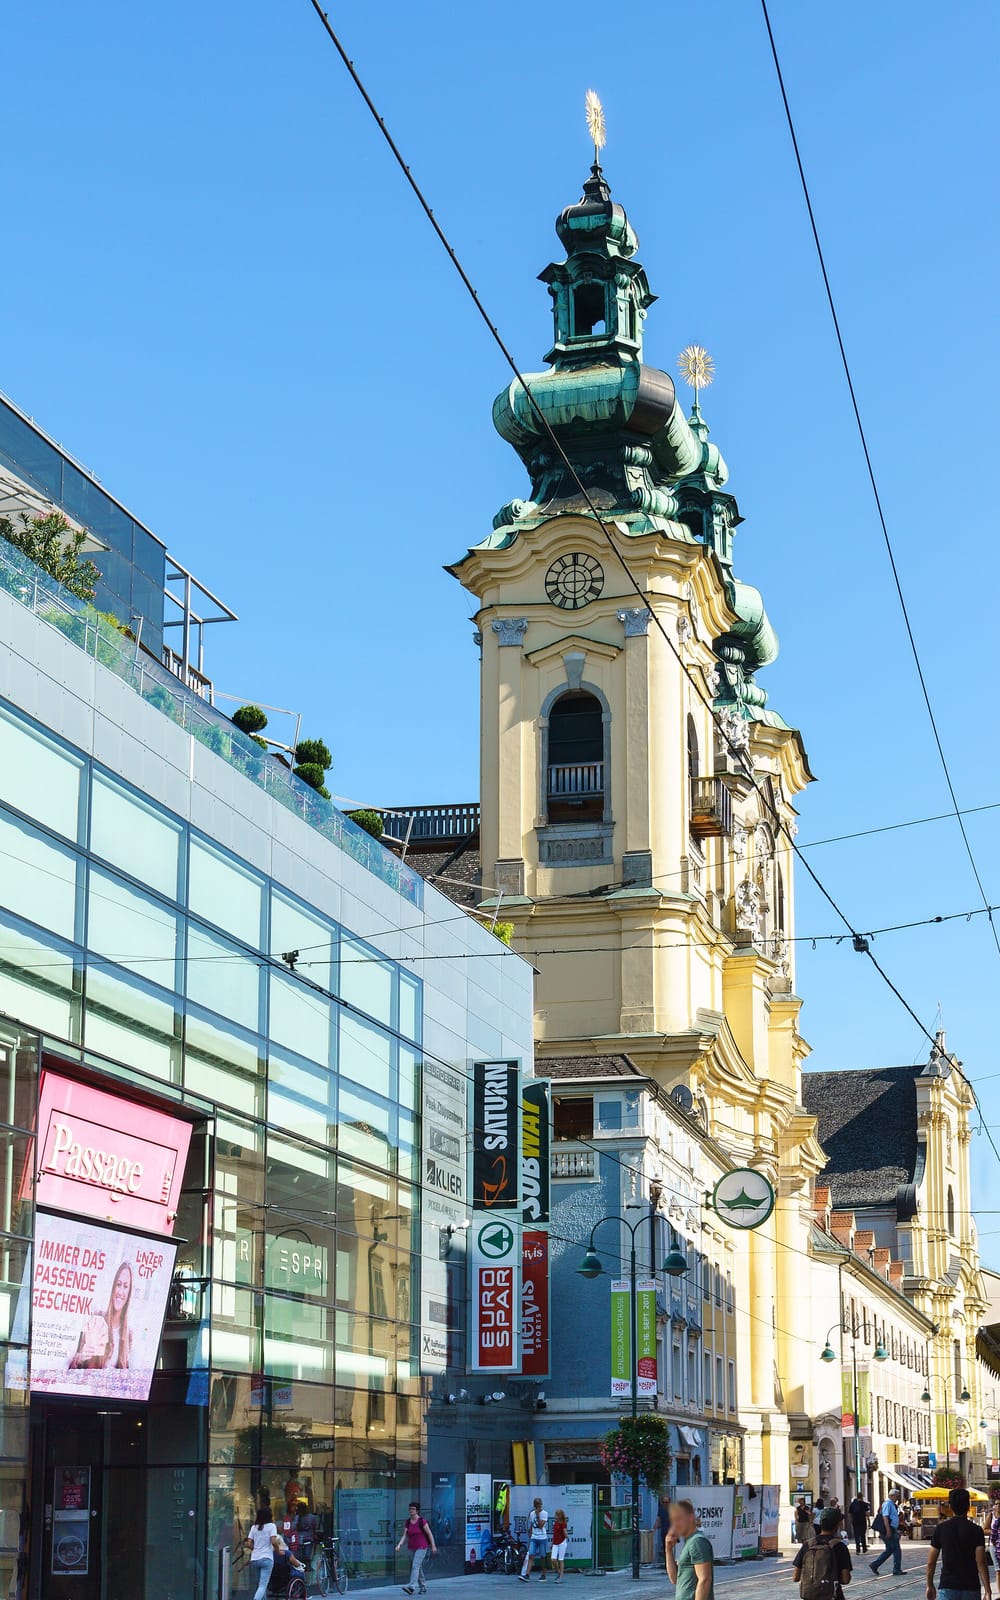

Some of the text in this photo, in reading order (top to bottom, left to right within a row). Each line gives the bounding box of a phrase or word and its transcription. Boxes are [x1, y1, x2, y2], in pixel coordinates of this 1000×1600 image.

[484, 1064, 508, 1150] SATURN
[45, 1123, 144, 1202] Passage
[436, 1167, 462, 1197] KLIER
[522, 1098, 542, 1221] SUBWAY
[34, 1264, 97, 1292] PASSENDE
[39, 1240, 106, 1270] IMMER DAS
[482, 1270, 495, 1348] EURO
[496, 1269, 510, 1348] SPAR
